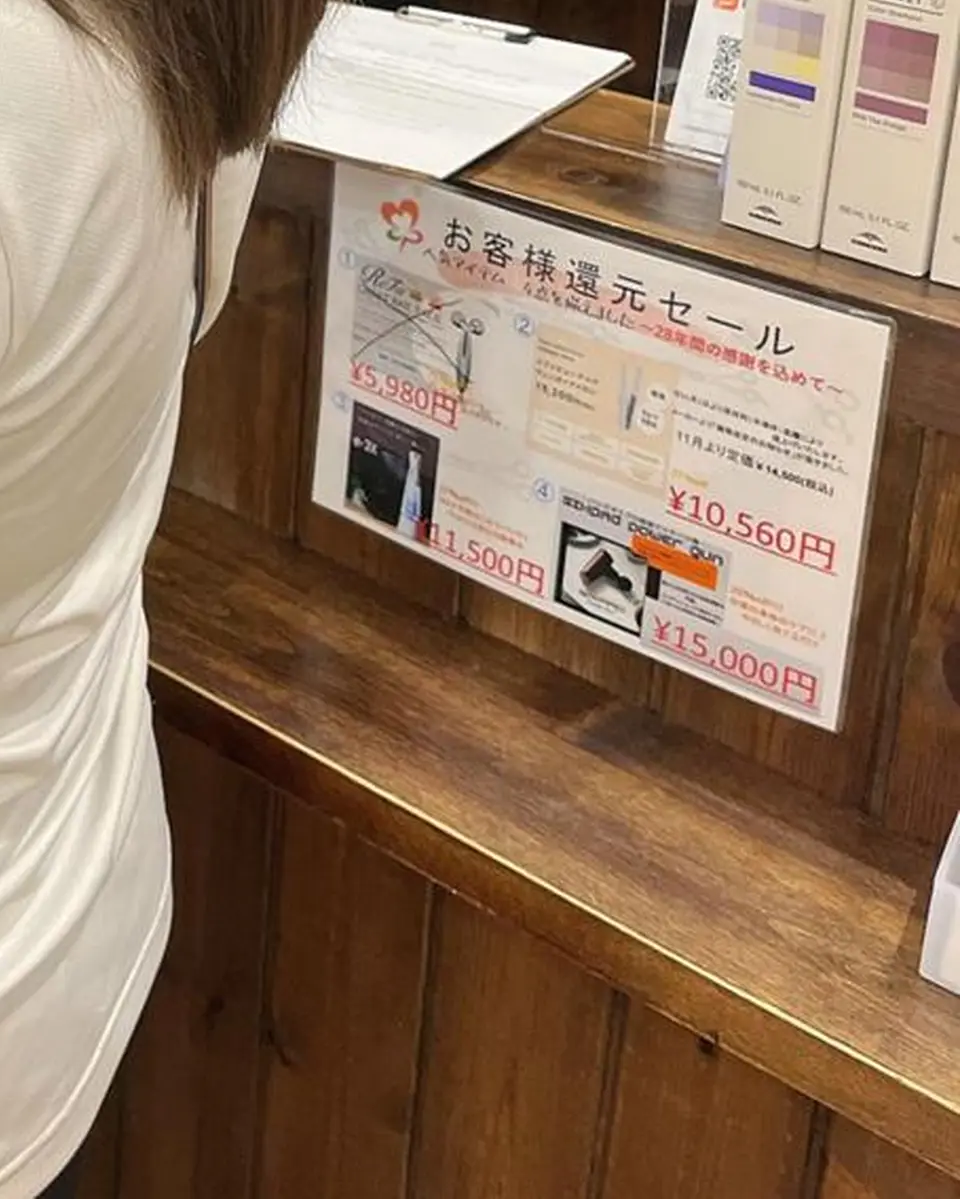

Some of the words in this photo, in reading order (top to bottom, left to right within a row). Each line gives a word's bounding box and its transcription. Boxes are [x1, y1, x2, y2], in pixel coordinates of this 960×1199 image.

[443, 217, 795, 355] お客様還元セール
[667, 484, 837, 572] ¥10,560円
[652, 614, 818, 705] ¥15,000円
